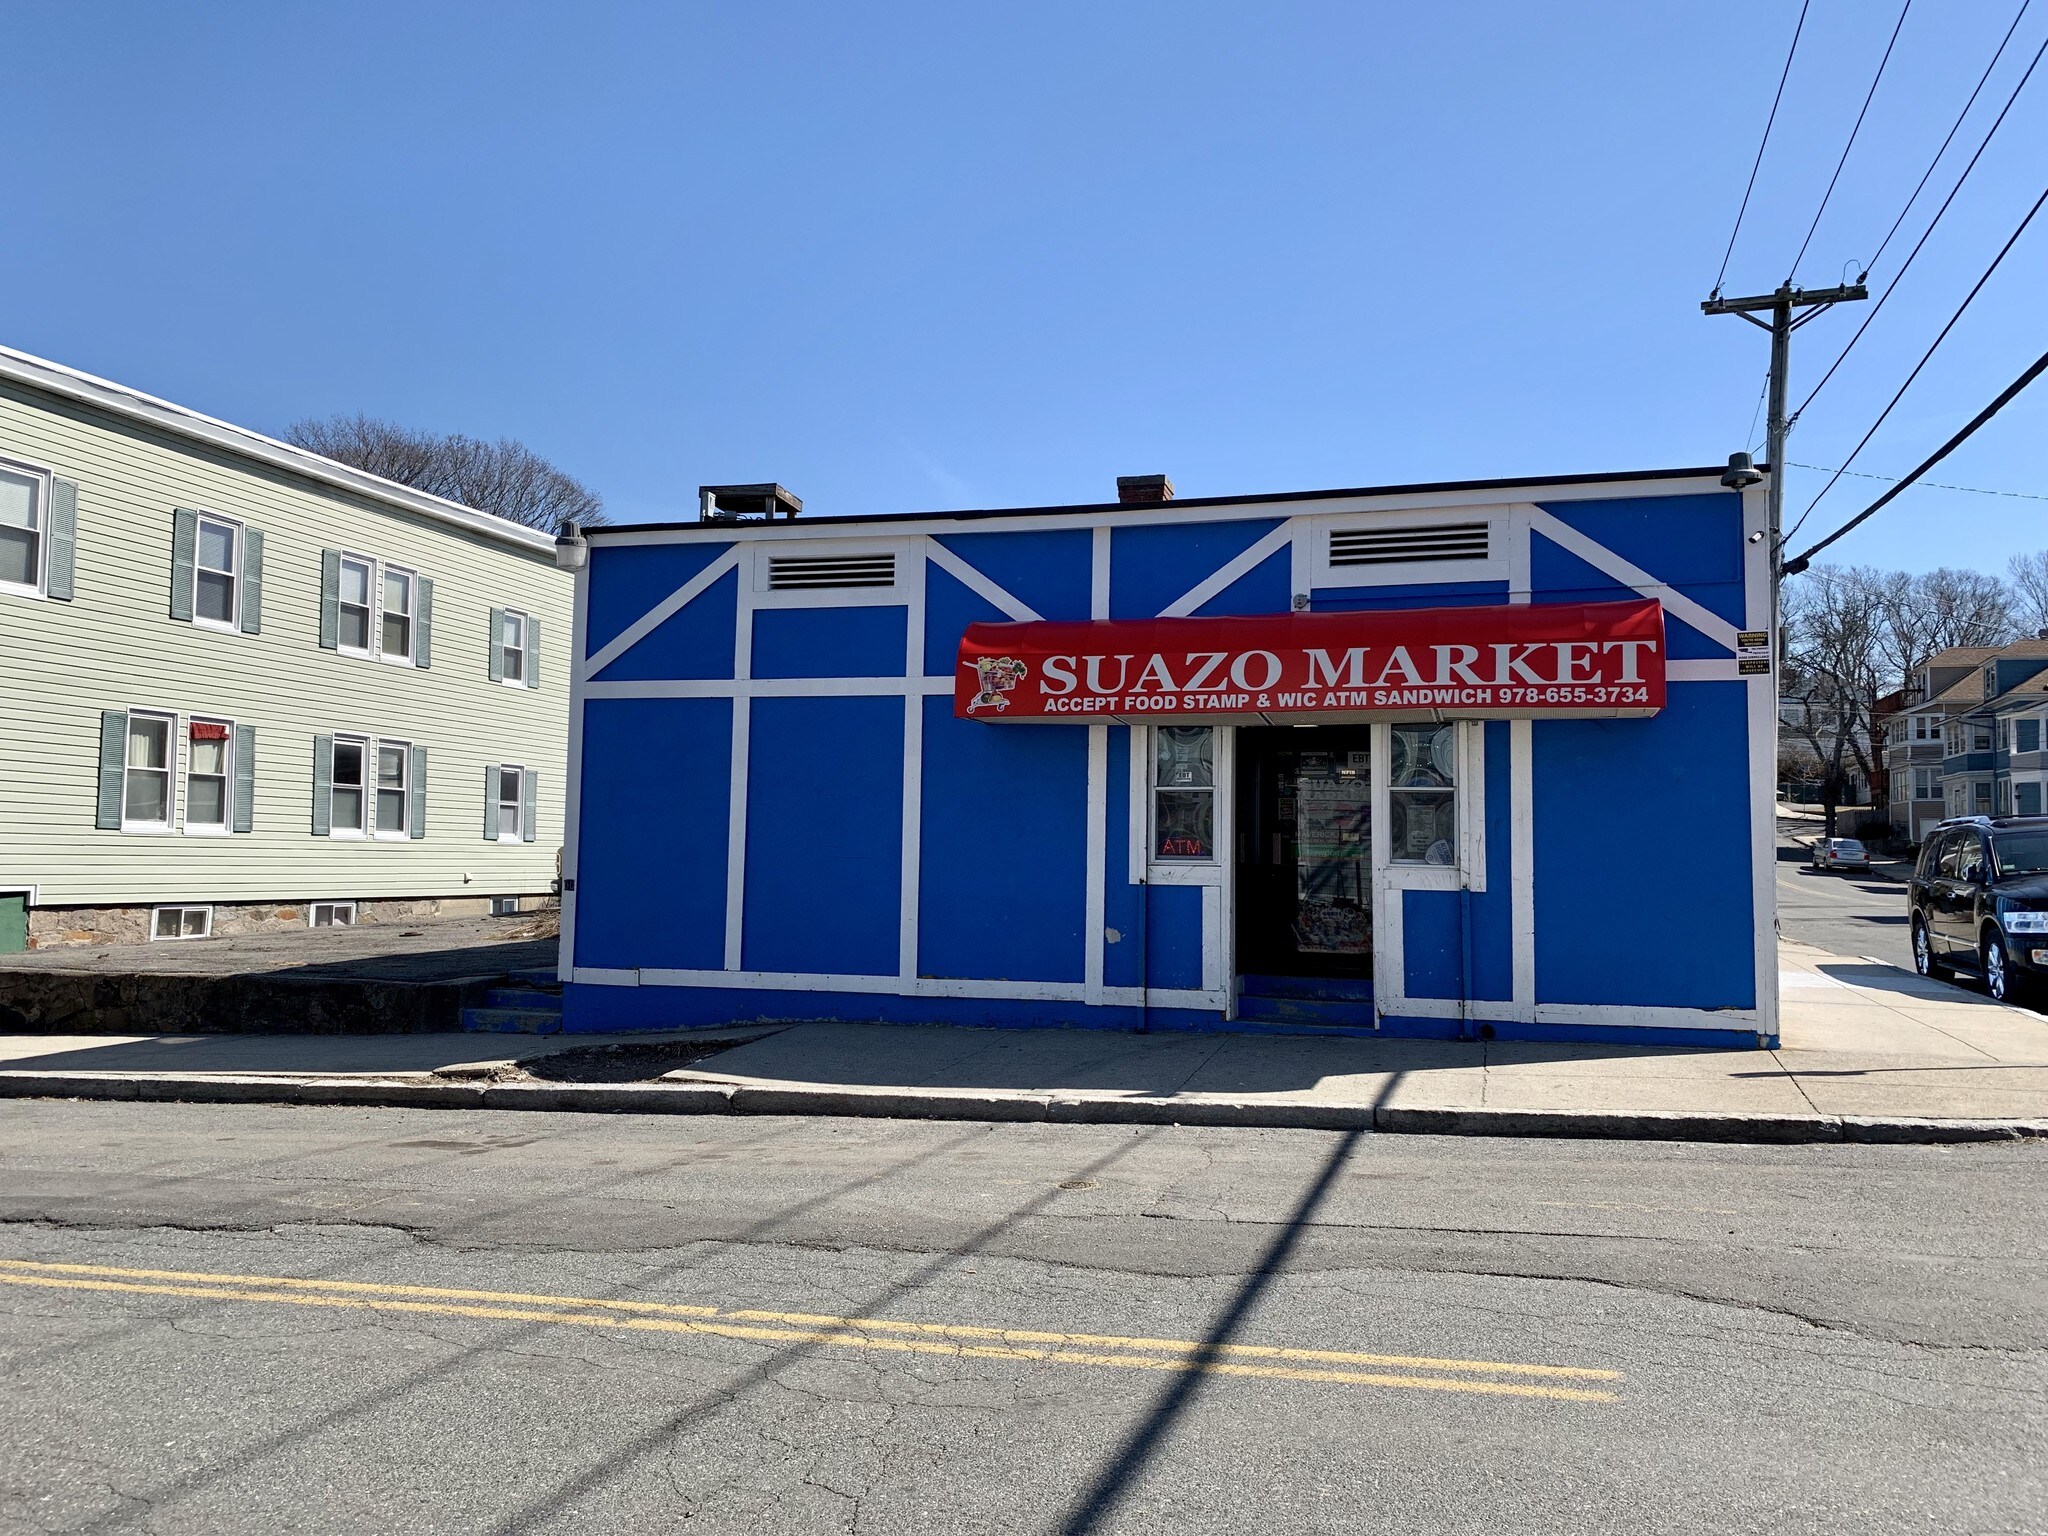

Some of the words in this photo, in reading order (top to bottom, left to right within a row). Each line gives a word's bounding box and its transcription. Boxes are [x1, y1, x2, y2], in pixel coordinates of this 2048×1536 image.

[1039, 650, 1283, 694] SUAZO
[1300, 640, 1657, 688] MARKET
[1043, 696, 1119, 712] ACCEPT
[1124, 695, 1178, 711] FOOD
[1183, 693, 1250, 709] STAMP
[1256, 693, 1271, 708] &
[1277, 692, 1317, 708] WIC
[1322, 690, 1367, 706] ATM
[1373, 688, 1492, 705] SANDWICH
[1499, 686, 1649, 704] 978-655-3734
[1352, 754, 1370, 763] EBT
[1162, 839, 1201, 854] ATM
